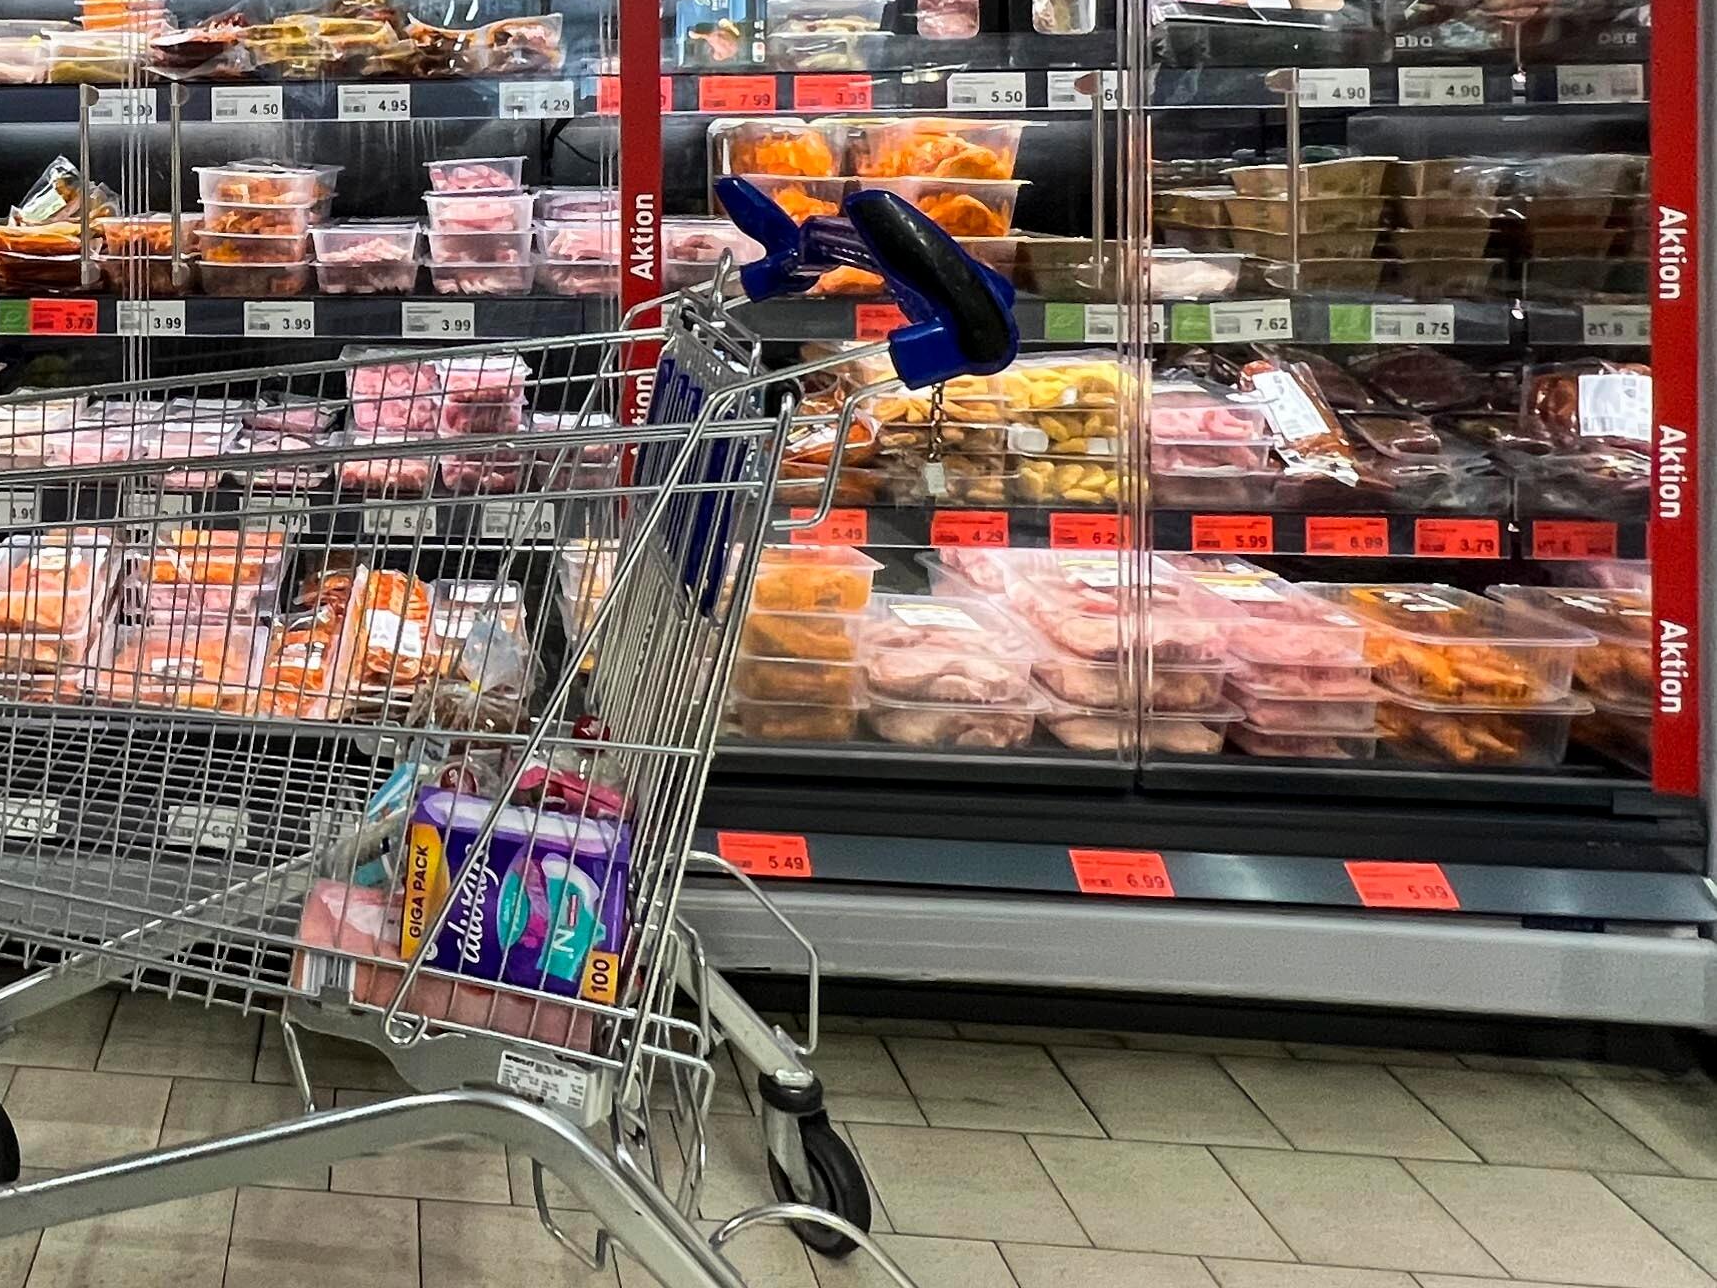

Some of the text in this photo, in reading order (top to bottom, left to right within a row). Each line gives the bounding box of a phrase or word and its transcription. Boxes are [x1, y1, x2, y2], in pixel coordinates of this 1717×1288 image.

[1396, 35, 1432, 48] BBQ
[991, 90, 1022, 103] 5.50
[1332, 87, 1365, 100] 4.90
[1446, 85, 1480, 98] 4.90
[378, 99, 408, 112] 4.95
[540, 99, 570, 111] 4.29
[741, 94, 770, 107] 7.99
[249, 103, 278, 115] 4.50
[630, 193, 655, 280] Aktion
[1659, 205, 1686, 300] Aktion
[154, 317, 181, 329] 3.99
[282, 318, 311, 330] 3.99
[442, 319, 471, 331] 3.99
[1255, 317, 1288, 331] 7.62
[1416, 322, 1450, 336] 8.75
[1659, 424, 1686, 519] Aktion
[404, 517, 433, 530] 5.9
[832, 528, 862, 540] 5.49
[972, 530, 1004, 543] 4.29
[1092, 532, 1125, 545] 6.2
[1235, 535, 1267, 548] 5.99
[1460, 539, 1494, 552] 3.79
[1659, 619, 1686, 715] Aktion
[769, 856, 804, 870] 5.49
[1127, 874, 1165, 889] 6.99
[410, 844, 430, 938] GIGA PACK
[1409, 885, 1446, 901] 5.99
[590, 958, 610, 994] 100
